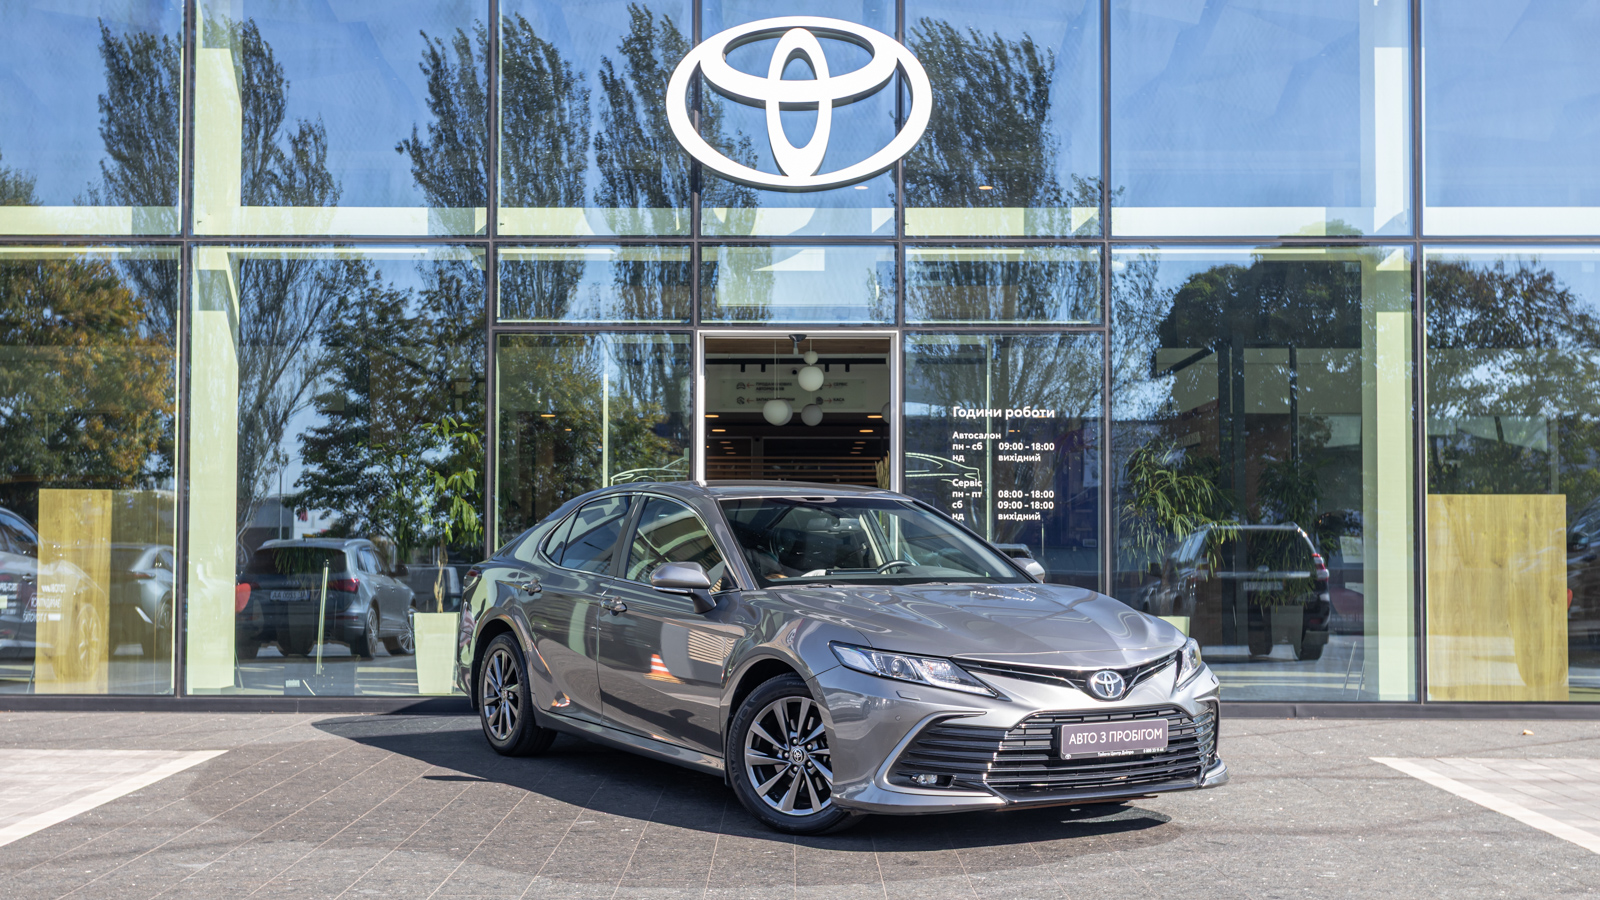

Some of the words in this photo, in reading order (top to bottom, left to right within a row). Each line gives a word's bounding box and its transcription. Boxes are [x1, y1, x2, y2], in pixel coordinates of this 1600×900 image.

[953, 406, 1002, 419] Години
[1005, 406, 1055, 420] роботи
[952, 431, 1001, 439] Автосалон
[972, 441, 983, 450] сб
[998, 442, 1024, 451] 09:00
[1031, 442, 1055, 451] 18:00
[998, 453, 1041, 462] вихідний
[952, 479, 982, 488] Сервіс
[998, 490, 1023, 498] 08:00
[1030, 490, 1055, 498] 18:00
[952, 500, 963, 509] сб
[998, 501, 1023, 509] 09:00
[1030, 501, 1054, 509] 18:00
[952, 513, 965, 521] нд
[998, 511, 1041, 521] вихідний
[1068, 732, 1098, 745] АВТО
[1109, 728, 1163, 743] ПРОБІГОМ
